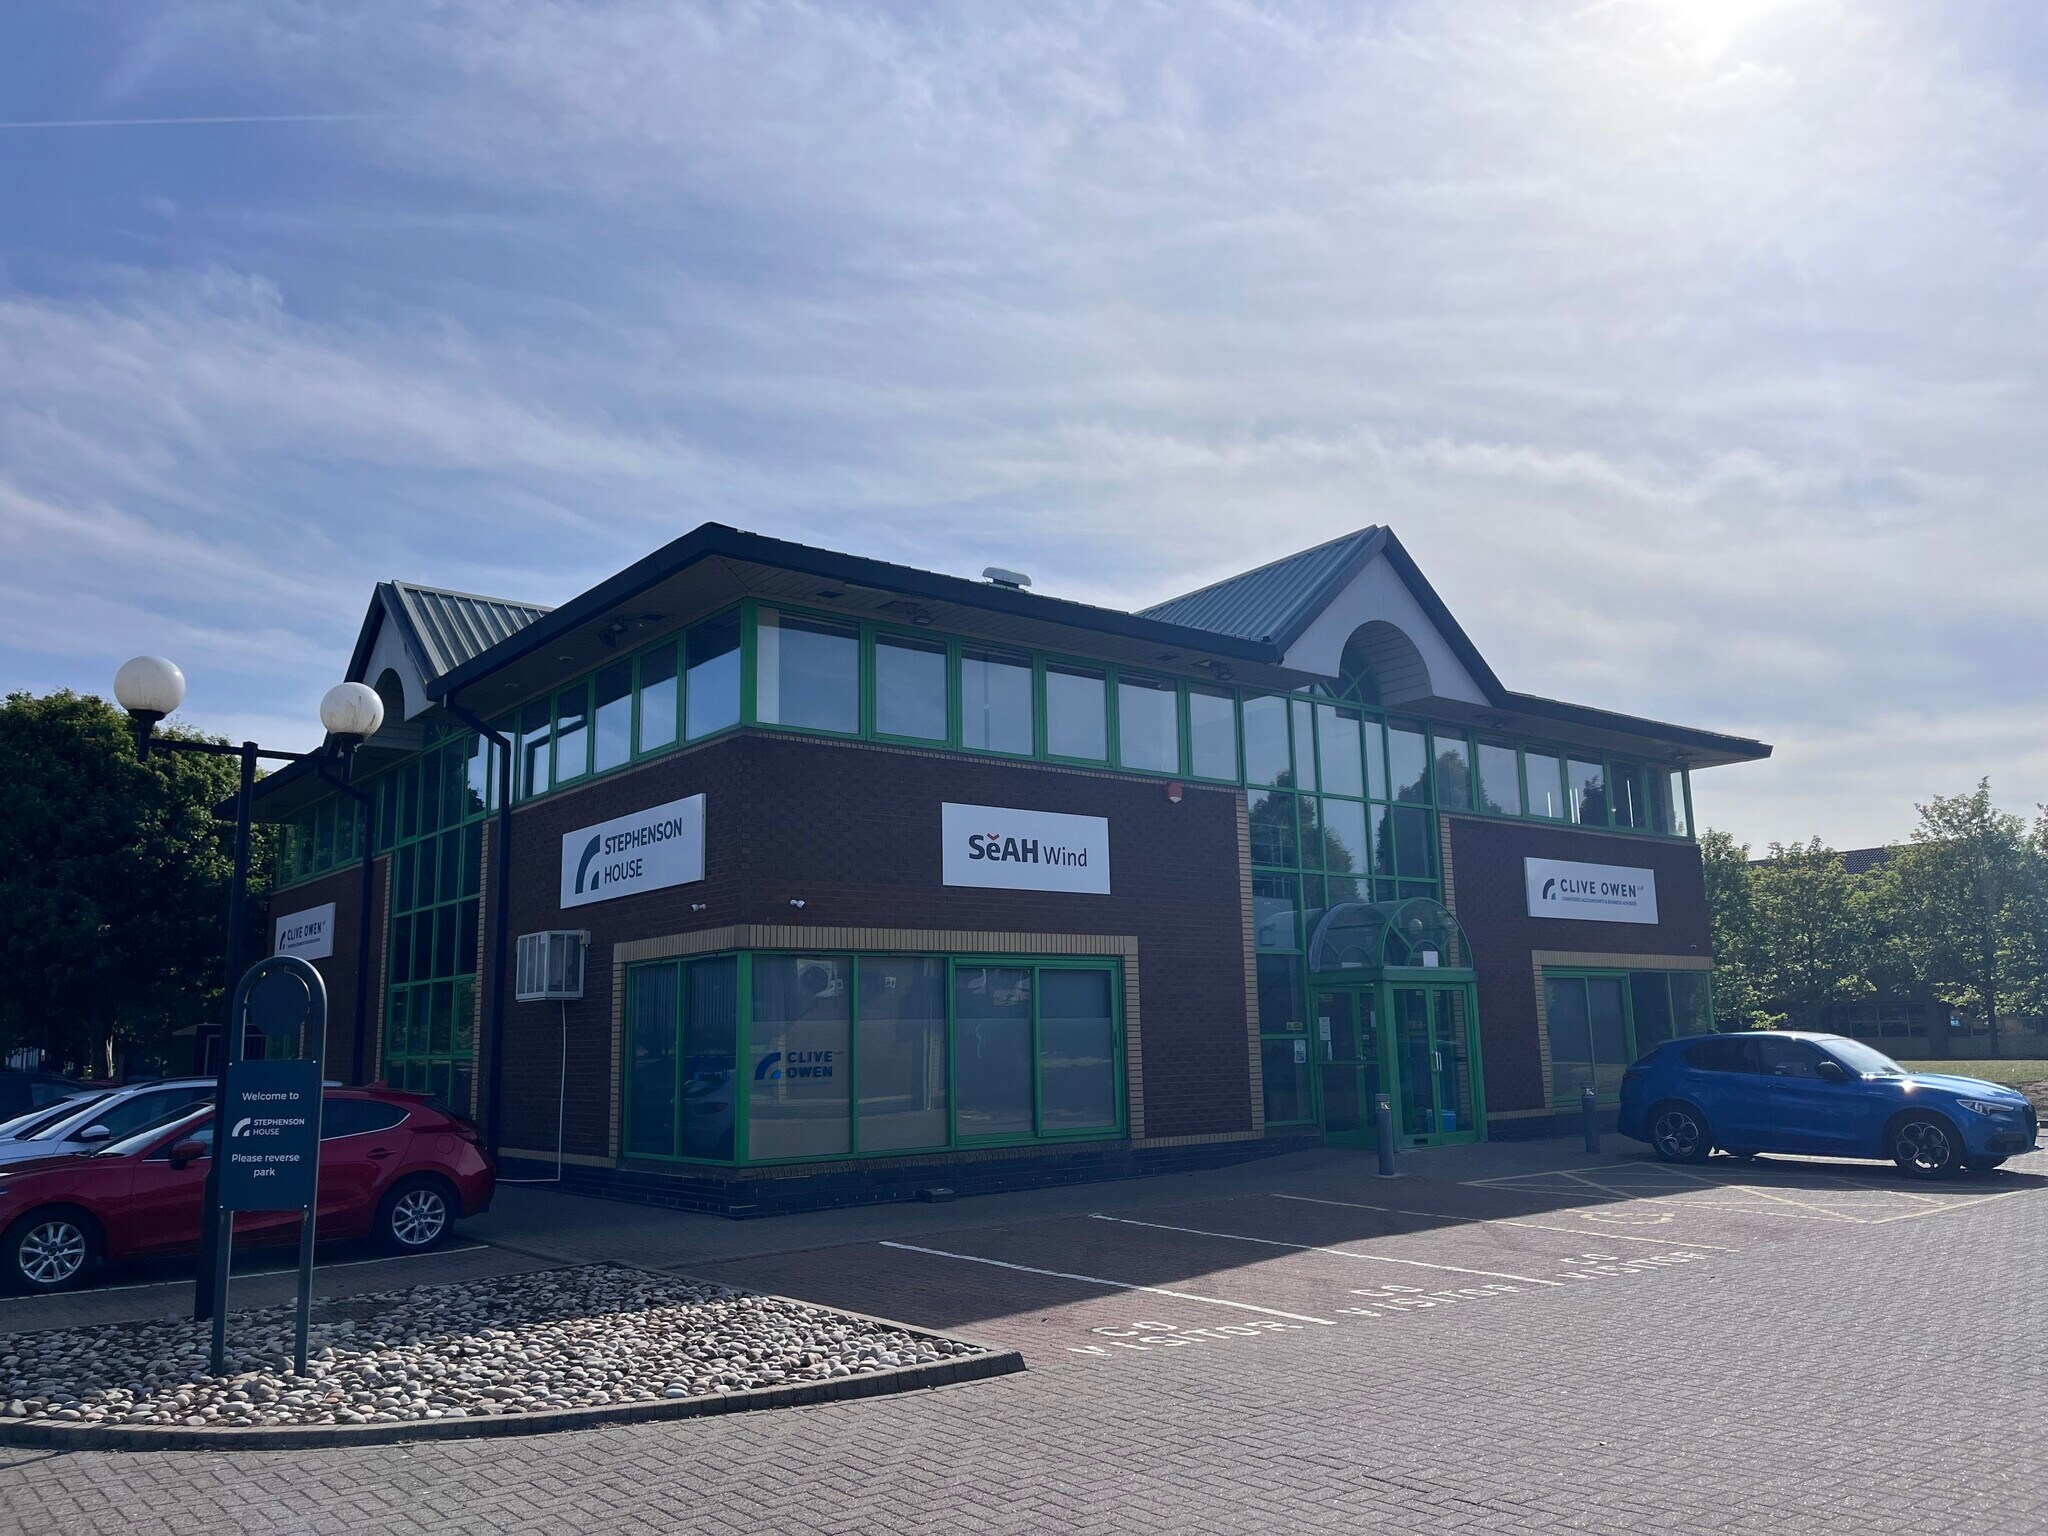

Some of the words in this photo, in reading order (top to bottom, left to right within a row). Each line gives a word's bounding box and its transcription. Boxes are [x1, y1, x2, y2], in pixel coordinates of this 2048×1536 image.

[604, 817, 682, 855] STEPHENSON
[1043, 846, 1088, 867] Wind
[604, 858, 643, 884] HOUSE
[1560, 879, 1596, 895] CLIVE
[1601, 882, 1637, 898] OWEN
[287, 926, 303, 941] CLIVE
[304, 922, 322, 937] OWEN
[787, 1051, 833, 1063] CLIVE
[787, 1066, 833, 1078] OWEN
[242, 1092, 287, 1101] Welcome
[289, 1092, 300, 1100] to
[253, 1118, 306, 1126] STEPHENSON
[253, 1128, 280, 1136] HOUSE
[231, 1154, 263, 1162] Please
[265, 1154, 300, 1162] reverse
[253, 1167, 276, 1178] park
[1556, 1251, 1715, 1280] VISITOR
[1335, 1284, 1530, 1317] VISITOR
[1065, 1321, 1304, 1357] VISITOR
